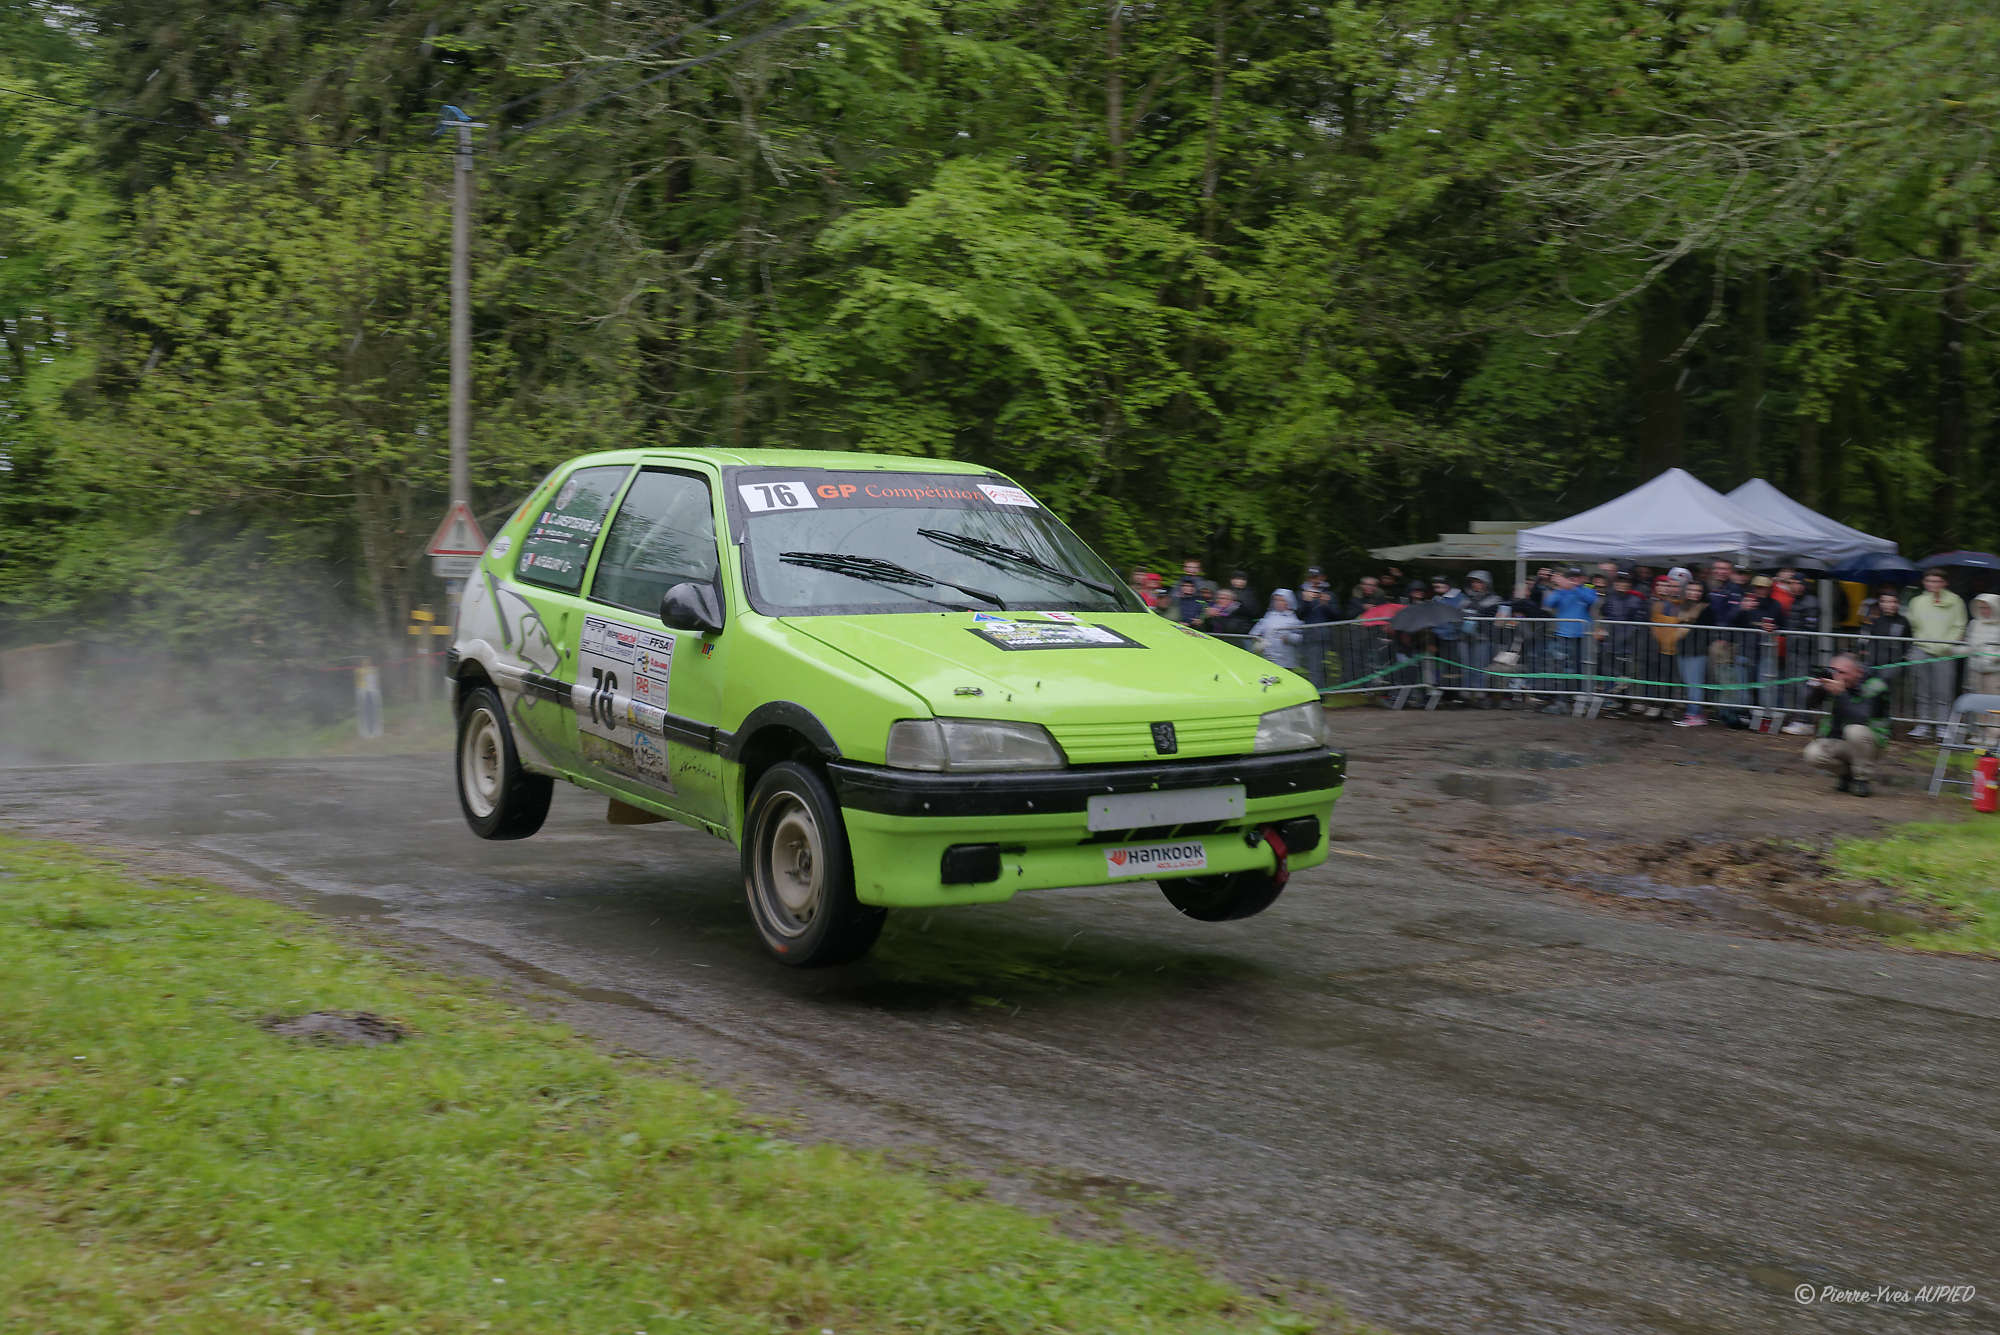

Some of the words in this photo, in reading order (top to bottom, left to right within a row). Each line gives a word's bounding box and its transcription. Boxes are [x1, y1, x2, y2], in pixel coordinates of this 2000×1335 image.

[754, 484, 799, 508] 76
[816, 484, 857, 499] GP
[865, 483, 985, 501] Compétition
[650, 637, 669, 650] FFSA
[590, 666, 618, 731] 76
